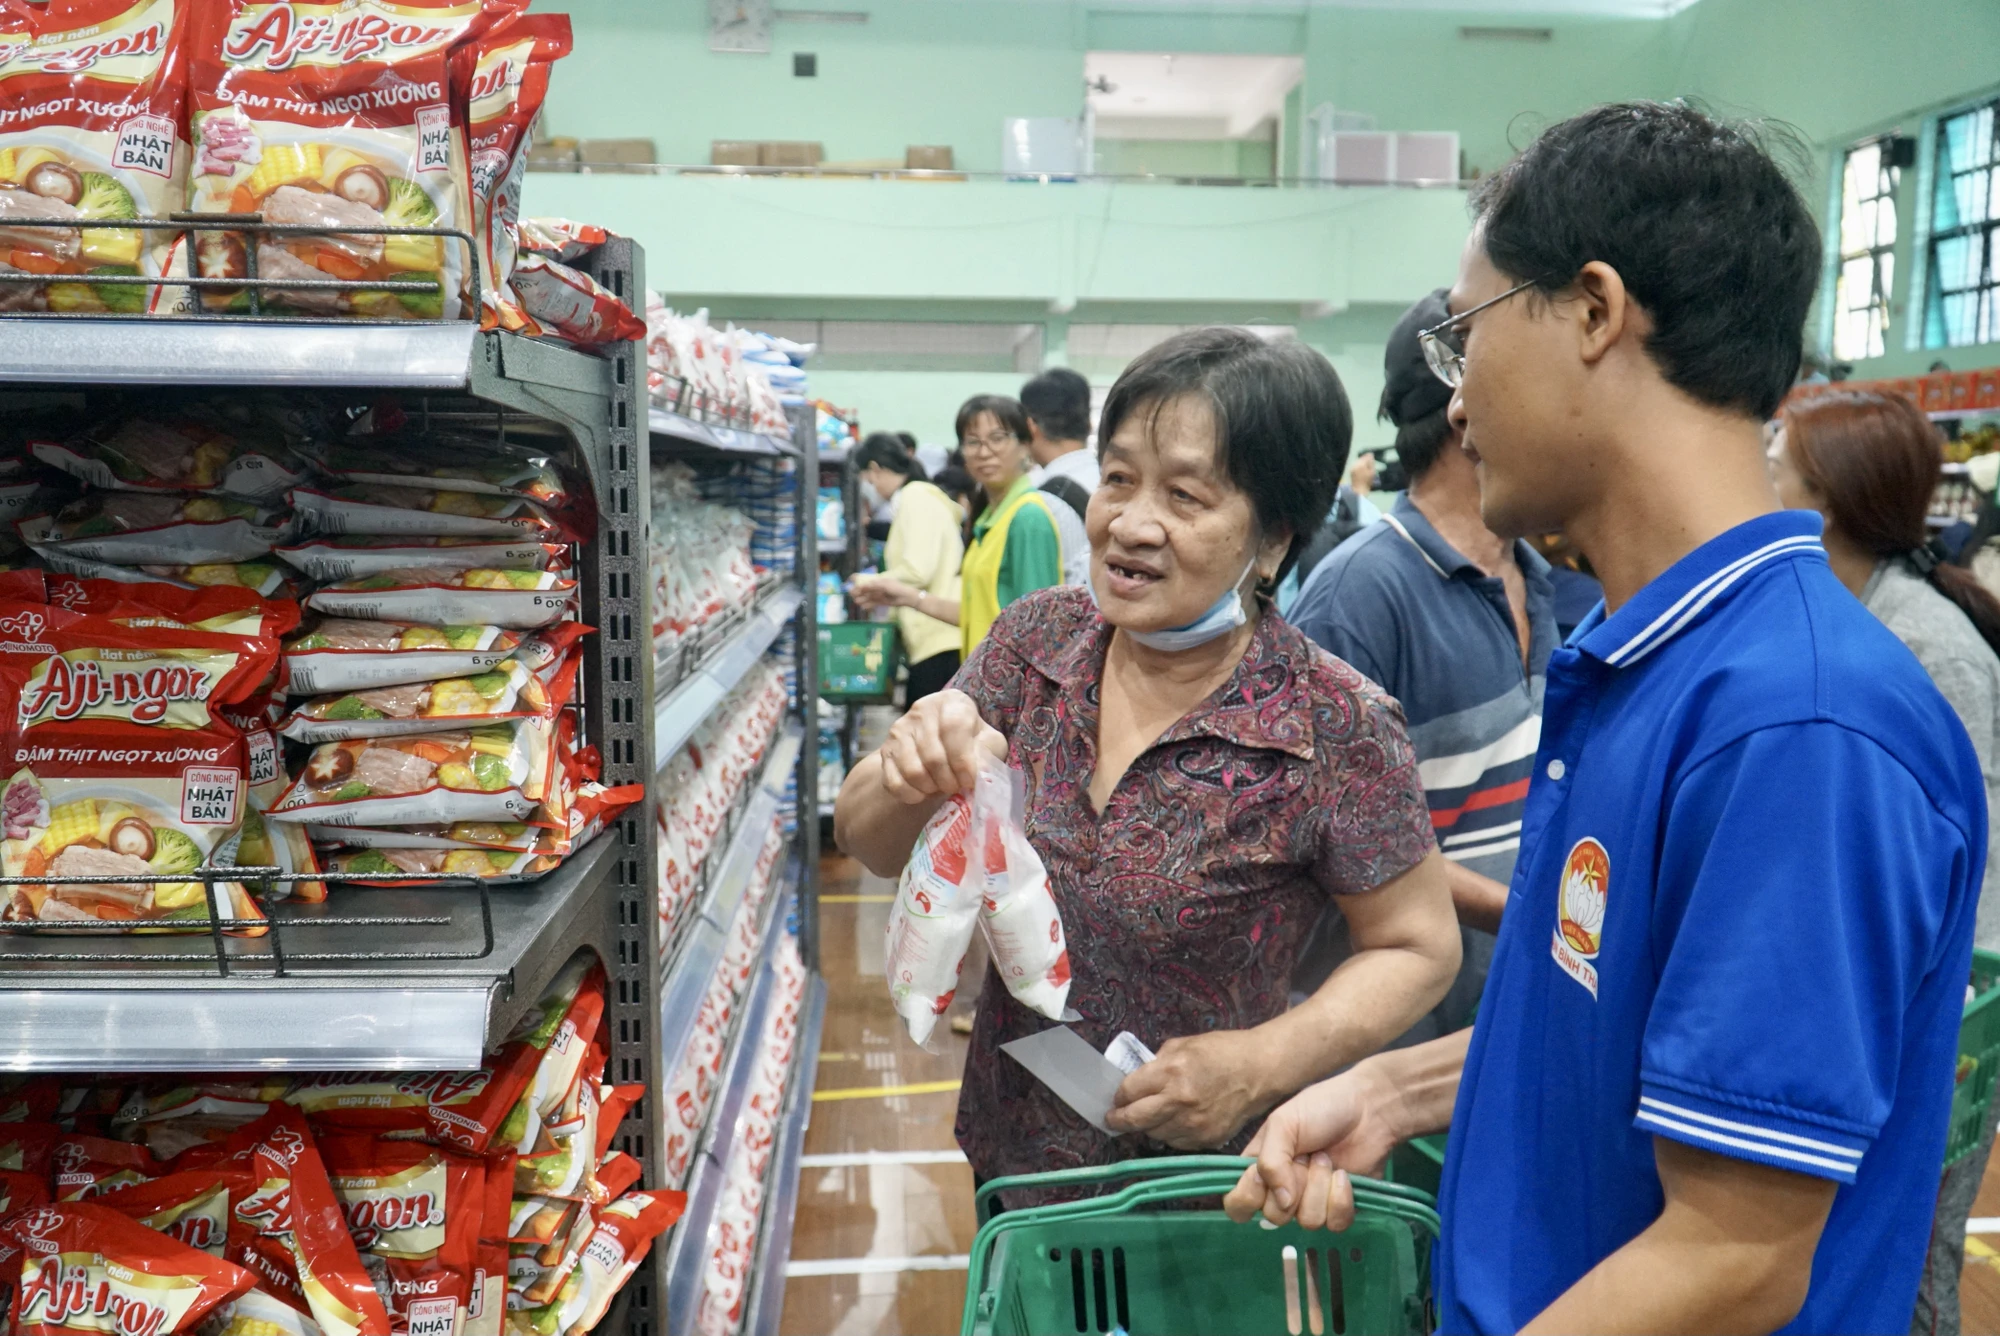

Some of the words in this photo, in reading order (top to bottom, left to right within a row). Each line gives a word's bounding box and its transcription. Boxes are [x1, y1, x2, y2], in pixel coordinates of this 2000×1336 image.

[321, 93, 373, 116] NGỌT
[375, 81, 441, 107] XƯƠNG
[20, 98, 75, 121] NGỌT
[121, 134, 172, 154] NHẬT
[122, 148, 164, 170] BẢN
[15, 745, 55, 765] ĐẬM
[57, 749, 99, 765] THỊT
[99, 749, 151, 765] NGỌT
[151, 747, 219, 763] XƯƠNG
[190, 772, 212, 783] CÔNG
[212, 772, 233, 785] NGHỆ
[187, 785, 235, 806] NHẬT
[191, 801, 227, 819] BẢN
[1557, 947, 1581, 975] BÌNH
